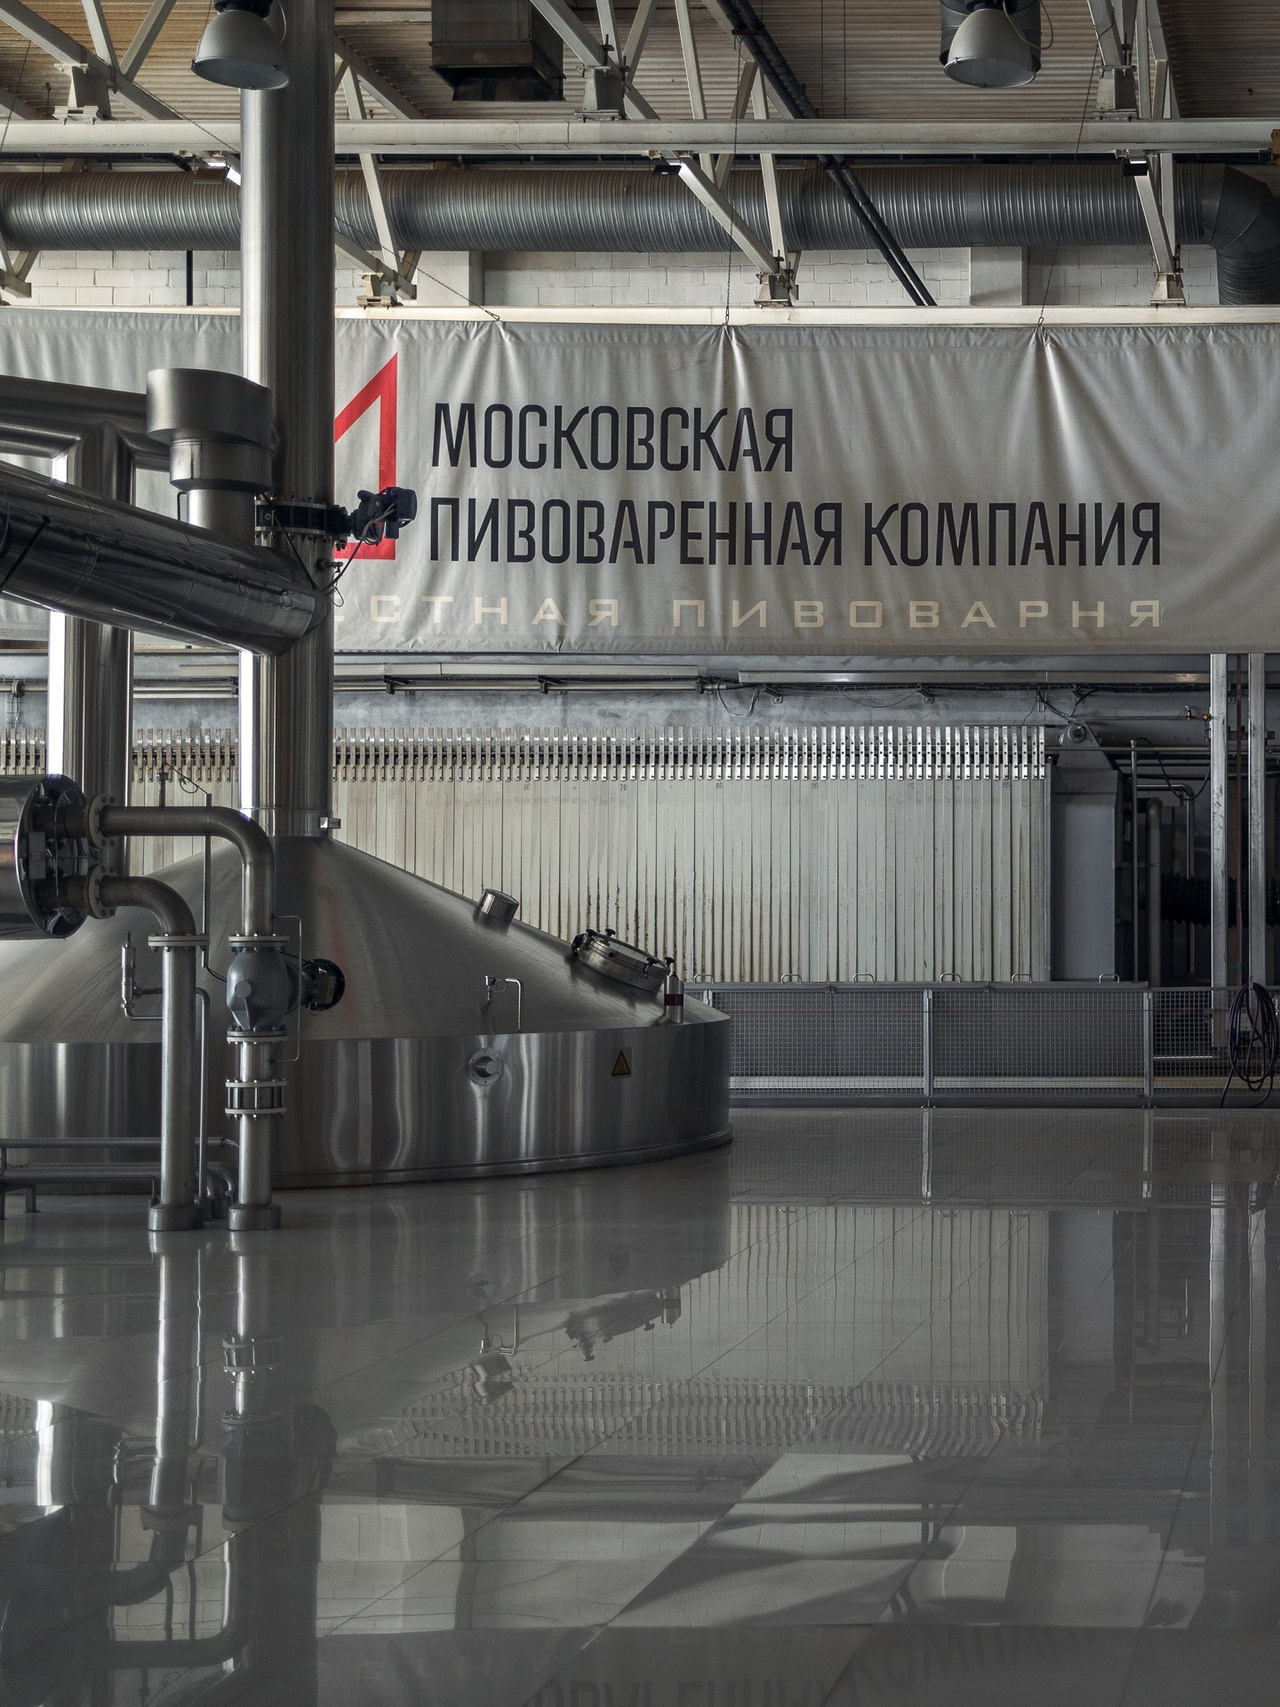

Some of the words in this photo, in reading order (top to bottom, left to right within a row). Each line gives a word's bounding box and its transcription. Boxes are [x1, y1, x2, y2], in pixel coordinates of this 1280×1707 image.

[432, 402, 794, 473] МОСКОВСКАЯ
[430, 497, 843, 567] ПИВОВАРЕННАЯ
[863, 501, 1162, 567] КОМПАНИЯ
[672, 599, 1161, 629] ПИВОВАРНЯ
